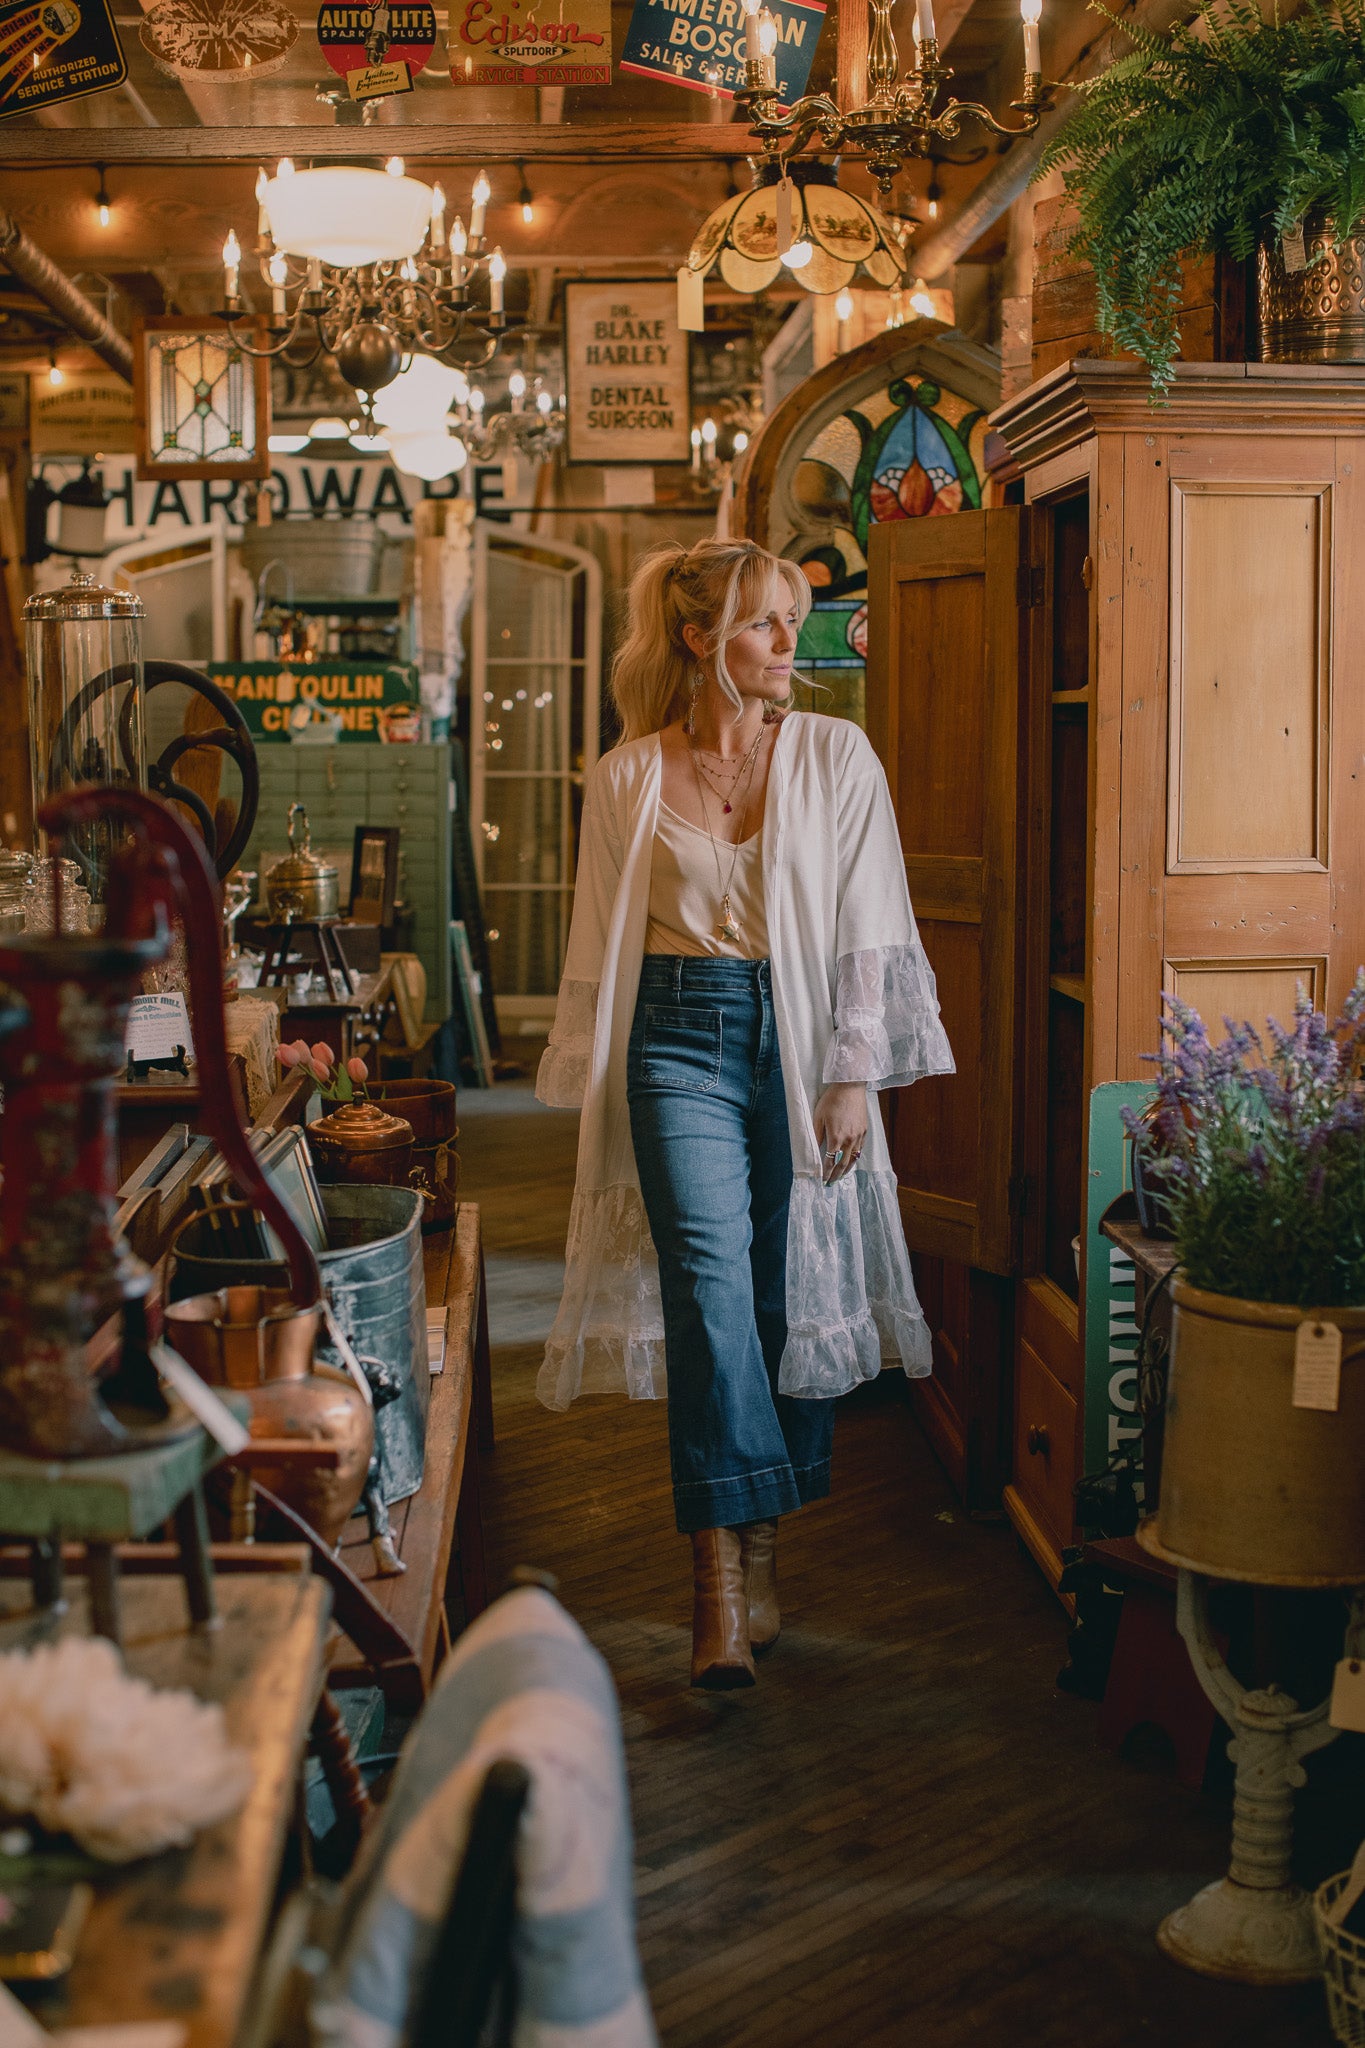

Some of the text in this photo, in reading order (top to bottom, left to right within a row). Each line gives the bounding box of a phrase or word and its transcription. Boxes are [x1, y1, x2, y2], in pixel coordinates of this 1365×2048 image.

[321, 10, 432, 28] AUTO LITE
[460, 0, 604, 46] Edison
[5, 26, 43, 58] SALES
[322, 30, 432, 38] SPARK PLUGS
[669, 17, 748, 64] BOSC
[504, 47, 558, 56] SPLITDORF
[33, 56, 97, 81] AUTHORIZED
[456, 68, 606, 82] SERVICE STATION
[639, 43, 788, 97] SALES & SERE
[17, 62, 119, 99] SERVICE STATION
[356, 75, 399, 91] Engineered
[594, 320, 664, 340] BLAKE
[586, 345, 670, 365] HARLEY
[591, 388, 670, 406] DENTAL
[588, 410, 674, 429] SURGEON
